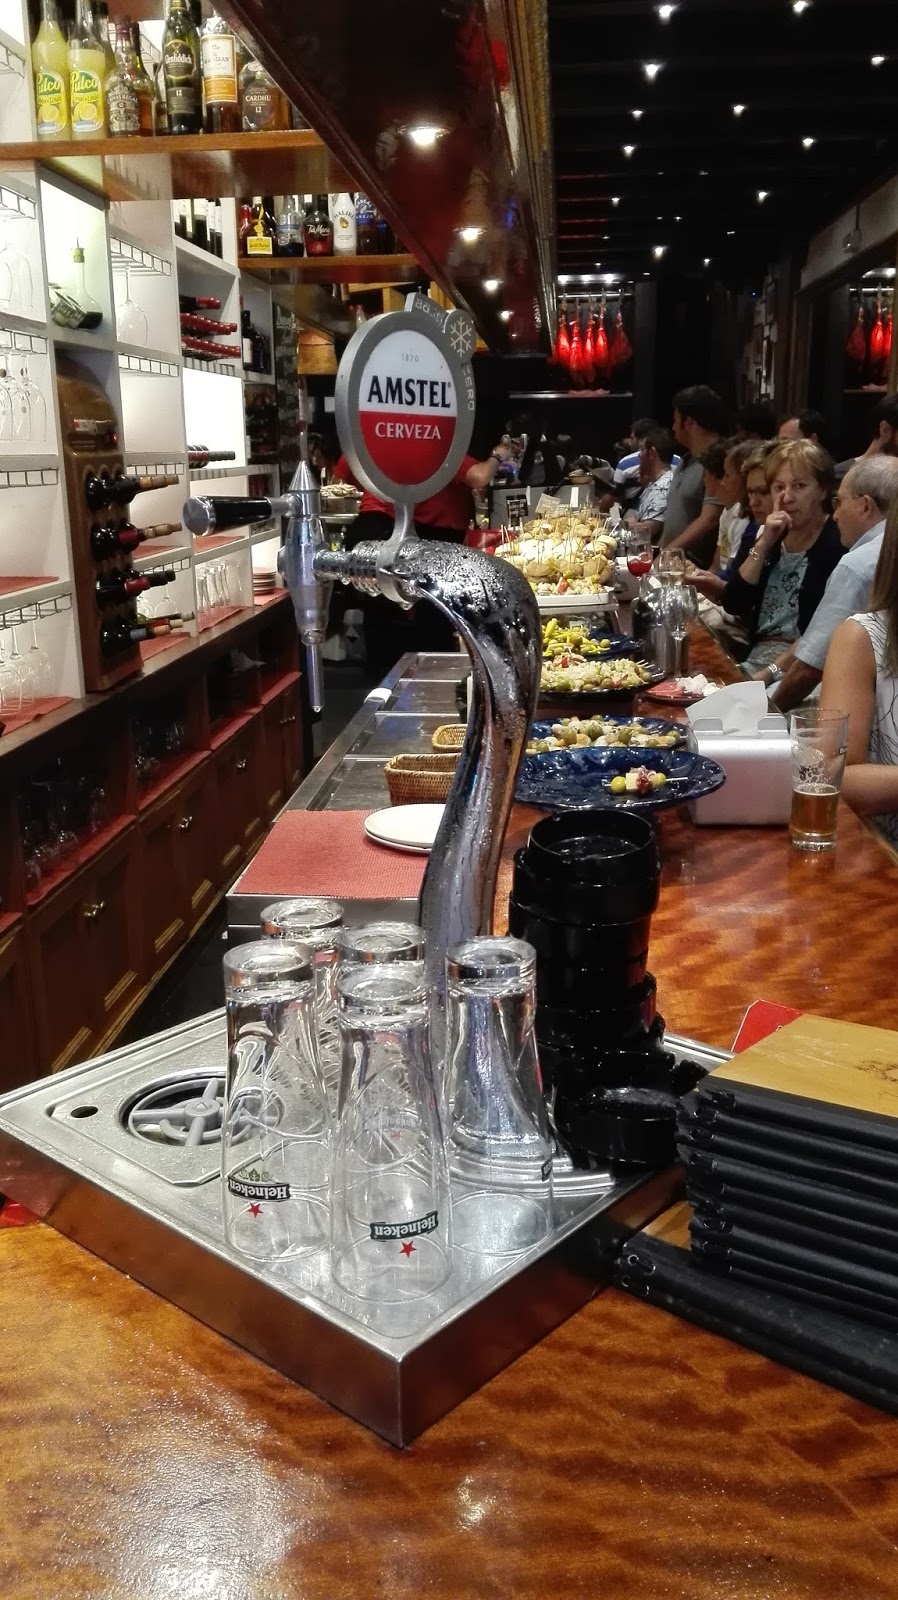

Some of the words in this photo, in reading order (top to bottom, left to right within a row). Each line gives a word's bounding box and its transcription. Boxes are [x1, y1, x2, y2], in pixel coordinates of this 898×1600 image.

[165, 53, 192, 64] Glenfiddich
[205, 56, 230, 64] MAALLAN
[36, 73, 60, 94] Pulco
[70, 71, 97, 92] Pulco
[401, 354, 420, 362] 1870
[367, 375, 451, 408] AMSTEL
[375, 422, 442, 440] CERVEZA
[229, 1179, 288, 1199] Heineken
[374, 1214, 436, 1238] Heineken
